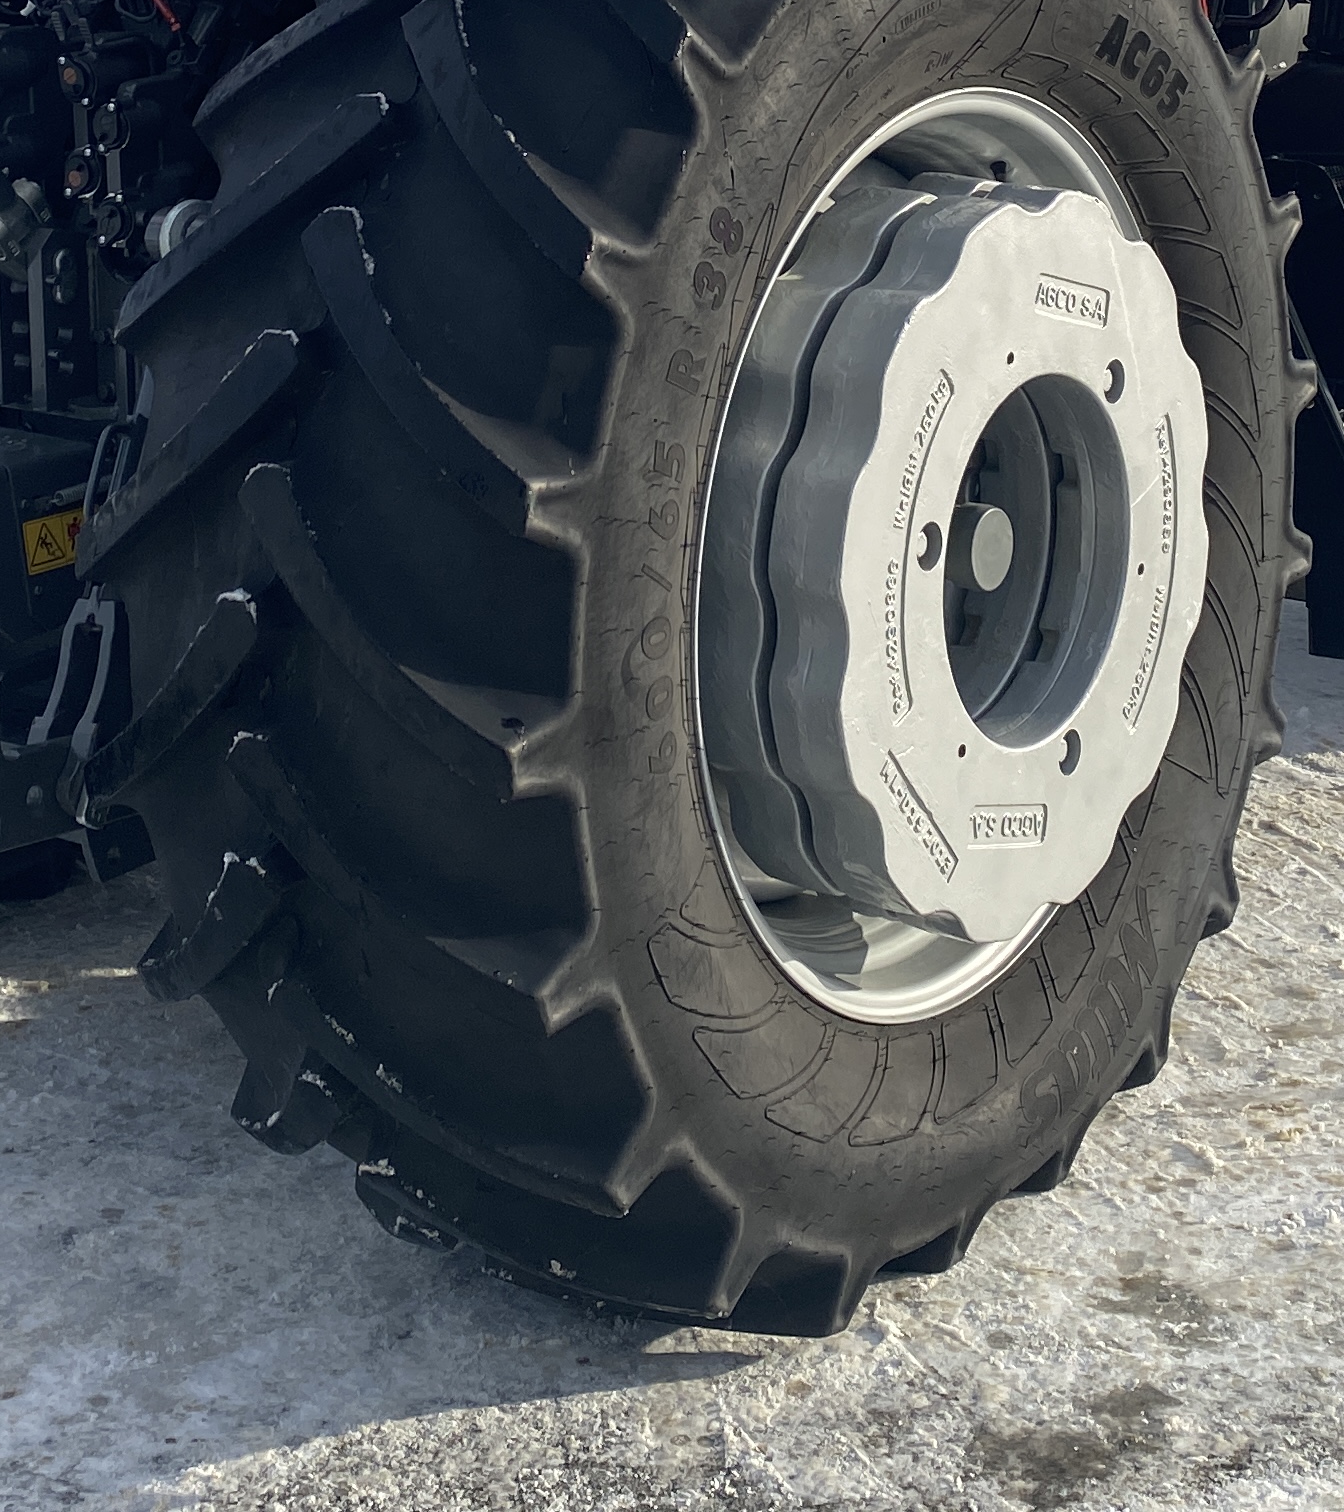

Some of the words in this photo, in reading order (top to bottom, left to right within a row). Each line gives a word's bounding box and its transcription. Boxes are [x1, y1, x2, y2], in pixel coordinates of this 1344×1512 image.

[1094, 12, 1191, 121] AC65
[1034, 279, 1076, 315] AGCO
[641, 438, 687, 776] 600/65
[665, 348, 708, 397] R
[693, 205, 746, 312] 38
[1000, 811, 1045, 839] AGCO
[1019, 884, 1159, 1128] Mitas
